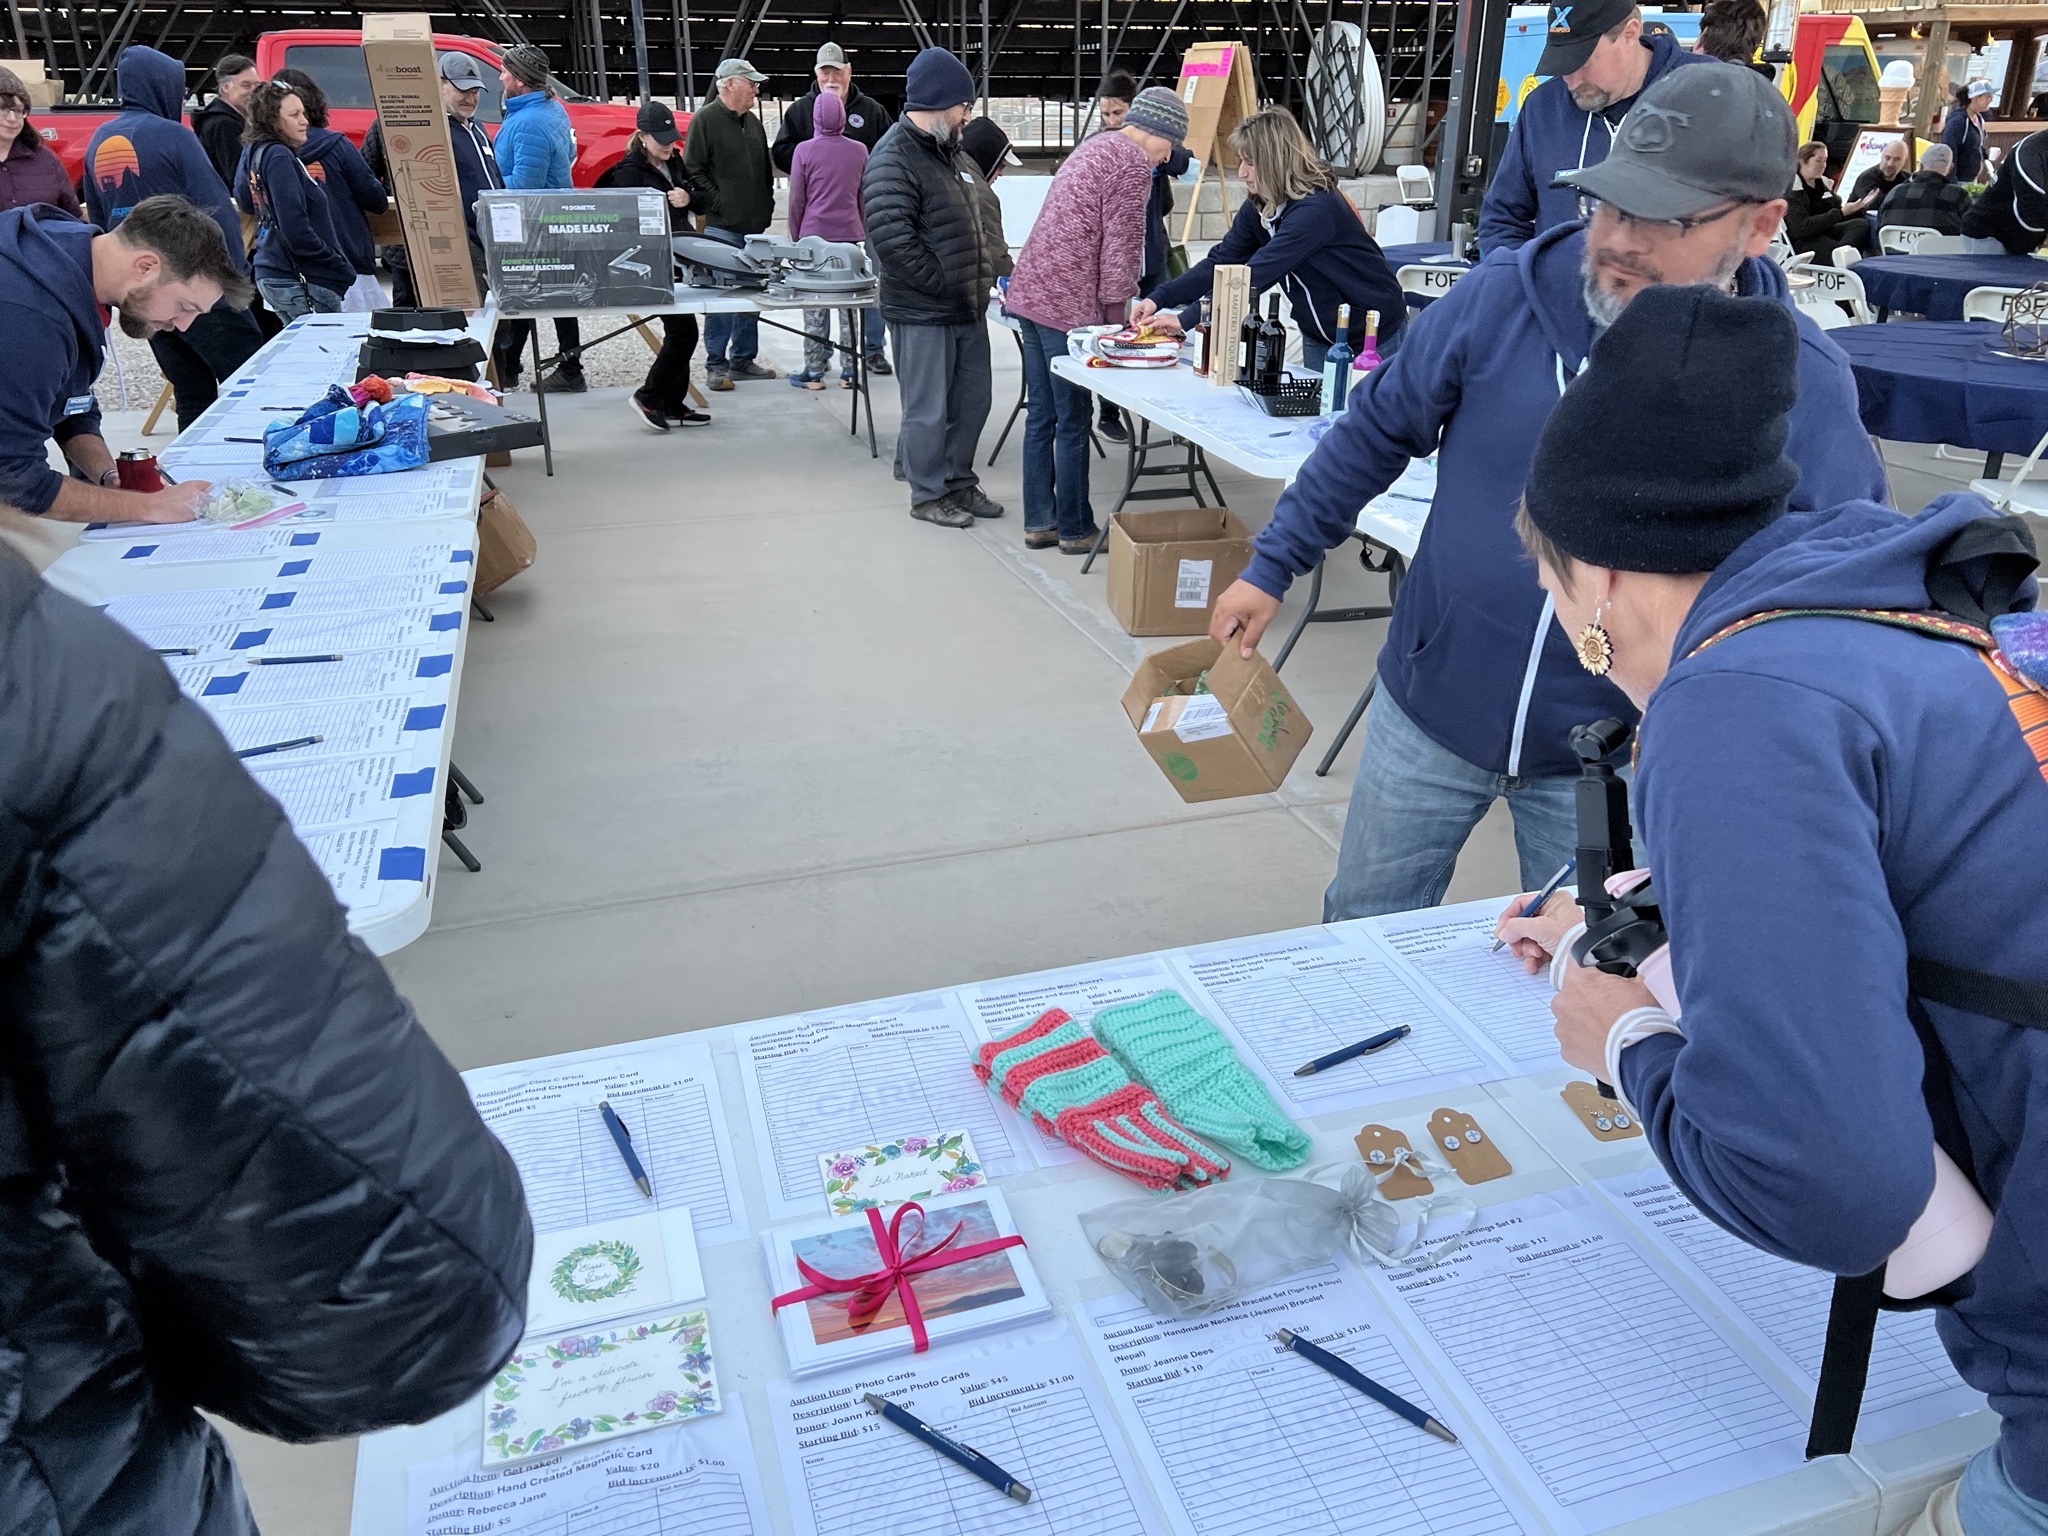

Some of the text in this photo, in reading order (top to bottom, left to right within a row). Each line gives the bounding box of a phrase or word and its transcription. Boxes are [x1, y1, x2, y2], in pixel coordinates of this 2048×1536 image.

[540, 213, 620, 224] MOBILE LIVING
[548, 224, 614, 234] MADE EASY.
[1425, 272, 1459, 288] FOF
[1817, 272, 1846, 291] FOF
[1227, 293, 1240, 381] MAESTRO TEQUILERO
[1193, 966, 1230, 975] Description:
[974, 994, 1002, 1003] Auction
[978, 1000, 1018, 1010] Description:
[984, 1014, 1011, 1023] Starting
[749, 1031, 776, 1041] Auction
[750, 1020, 878, 1047] Description: Created Magnetic
[885, 1028, 920, 1037] increment
[752, 1039, 810, 1053] Donor: Rebecca
[753, 1051, 782, 1061] Starting
[476, 1071, 639, 1106] Description: Hand Created Magnetic Card
[476, 1088, 506, 1098] Auction
[604, 1082, 628, 1090] Value:
[622, 1085, 660, 1096] increment
[673, 1077, 694, 1086] $1.00
[504, 1097, 540, 1107] Rebecca
[1623, 1183, 1671, 1199] Auction Item:
[1632, 1194, 1678, 1208] Description:
[1642, 1208, 1670, 1218] Donor:
[1495, 1220, 1509, 1229] Set
[1653, 1216, 1686, 1227] Starting
[1470, 1236, 1504, 1248] Earrings
[1505, 1242, 1530, 1253] Value:
[1516, 1234, 1604, 1263] Bid increment $1.00
[1387, 1254, 1473, 1281] Donor: BethAnn Reid
[1396, 1274, 1446, 1292] Starting Bid:
[1103, 1328, 1133, 1340] Auction
[1134, 1322, 1154, 1332] Item:
[1227, 1302, 1240, 1310] and
[1241, 1294, 1272, 1306] Bracelet
[1273, 1290, 1286, 1299] Set
[1288, 1286, 1305, 1296] (Tiger
[1306, 1284, 1318, 1292] Eye
[1324, 1278, 1342, 1288] Onyx)
[1108, 1293, 1325, 1352] Description: Handmade Necklace (Jeannie) Bracelet
[1295, 1325, 1310, 1335] $30
[1347, 1323, 1371, 1335] $1.00
[1114, 1350, 1146, 1364] (Nepal)
[1120, 1348, 1214, 1376] Donor: Jeannie Dees
[539, 1376, 573, 1391] I'm
[593, 1360, 640, 1379] delicate
[611, 1371, 656, 1392] flower
[1126, 1364, 1203, 1390] Starting Bid: 10
[790, 1370, 916, 1407] Auction Item: Photo Cards
[960, 1376, 1008, 1395] Value: $45
[968, 1374, 1075, 1408] Bid increment is: $1.00
[793, 1371, 970, 1421] Description: Photo Cards
[1023, 1400, 1047, 1410] Amount
[795, 1413, 863, 1435] Donor: Joann
[799, 1423, 880, 1449] Starting Bid: $15
[605, 1462, 660, 1475] Value: $20
[805, 1456, 824, 1465] Name
[429, 1456, 563, 1497] Auction Item: Get naked!
[429, 1447, 653, 1512] Description: Hand Created Magnetic Card
[608, 1458, 725, 1489] Bid increment $1.00
[673, 1478, 701, 1489] Amount
[427, 1492, 547, 1525] Donor: Rebecca Jane
[426, 1517, 511, 1536] Starting Bid: $5
